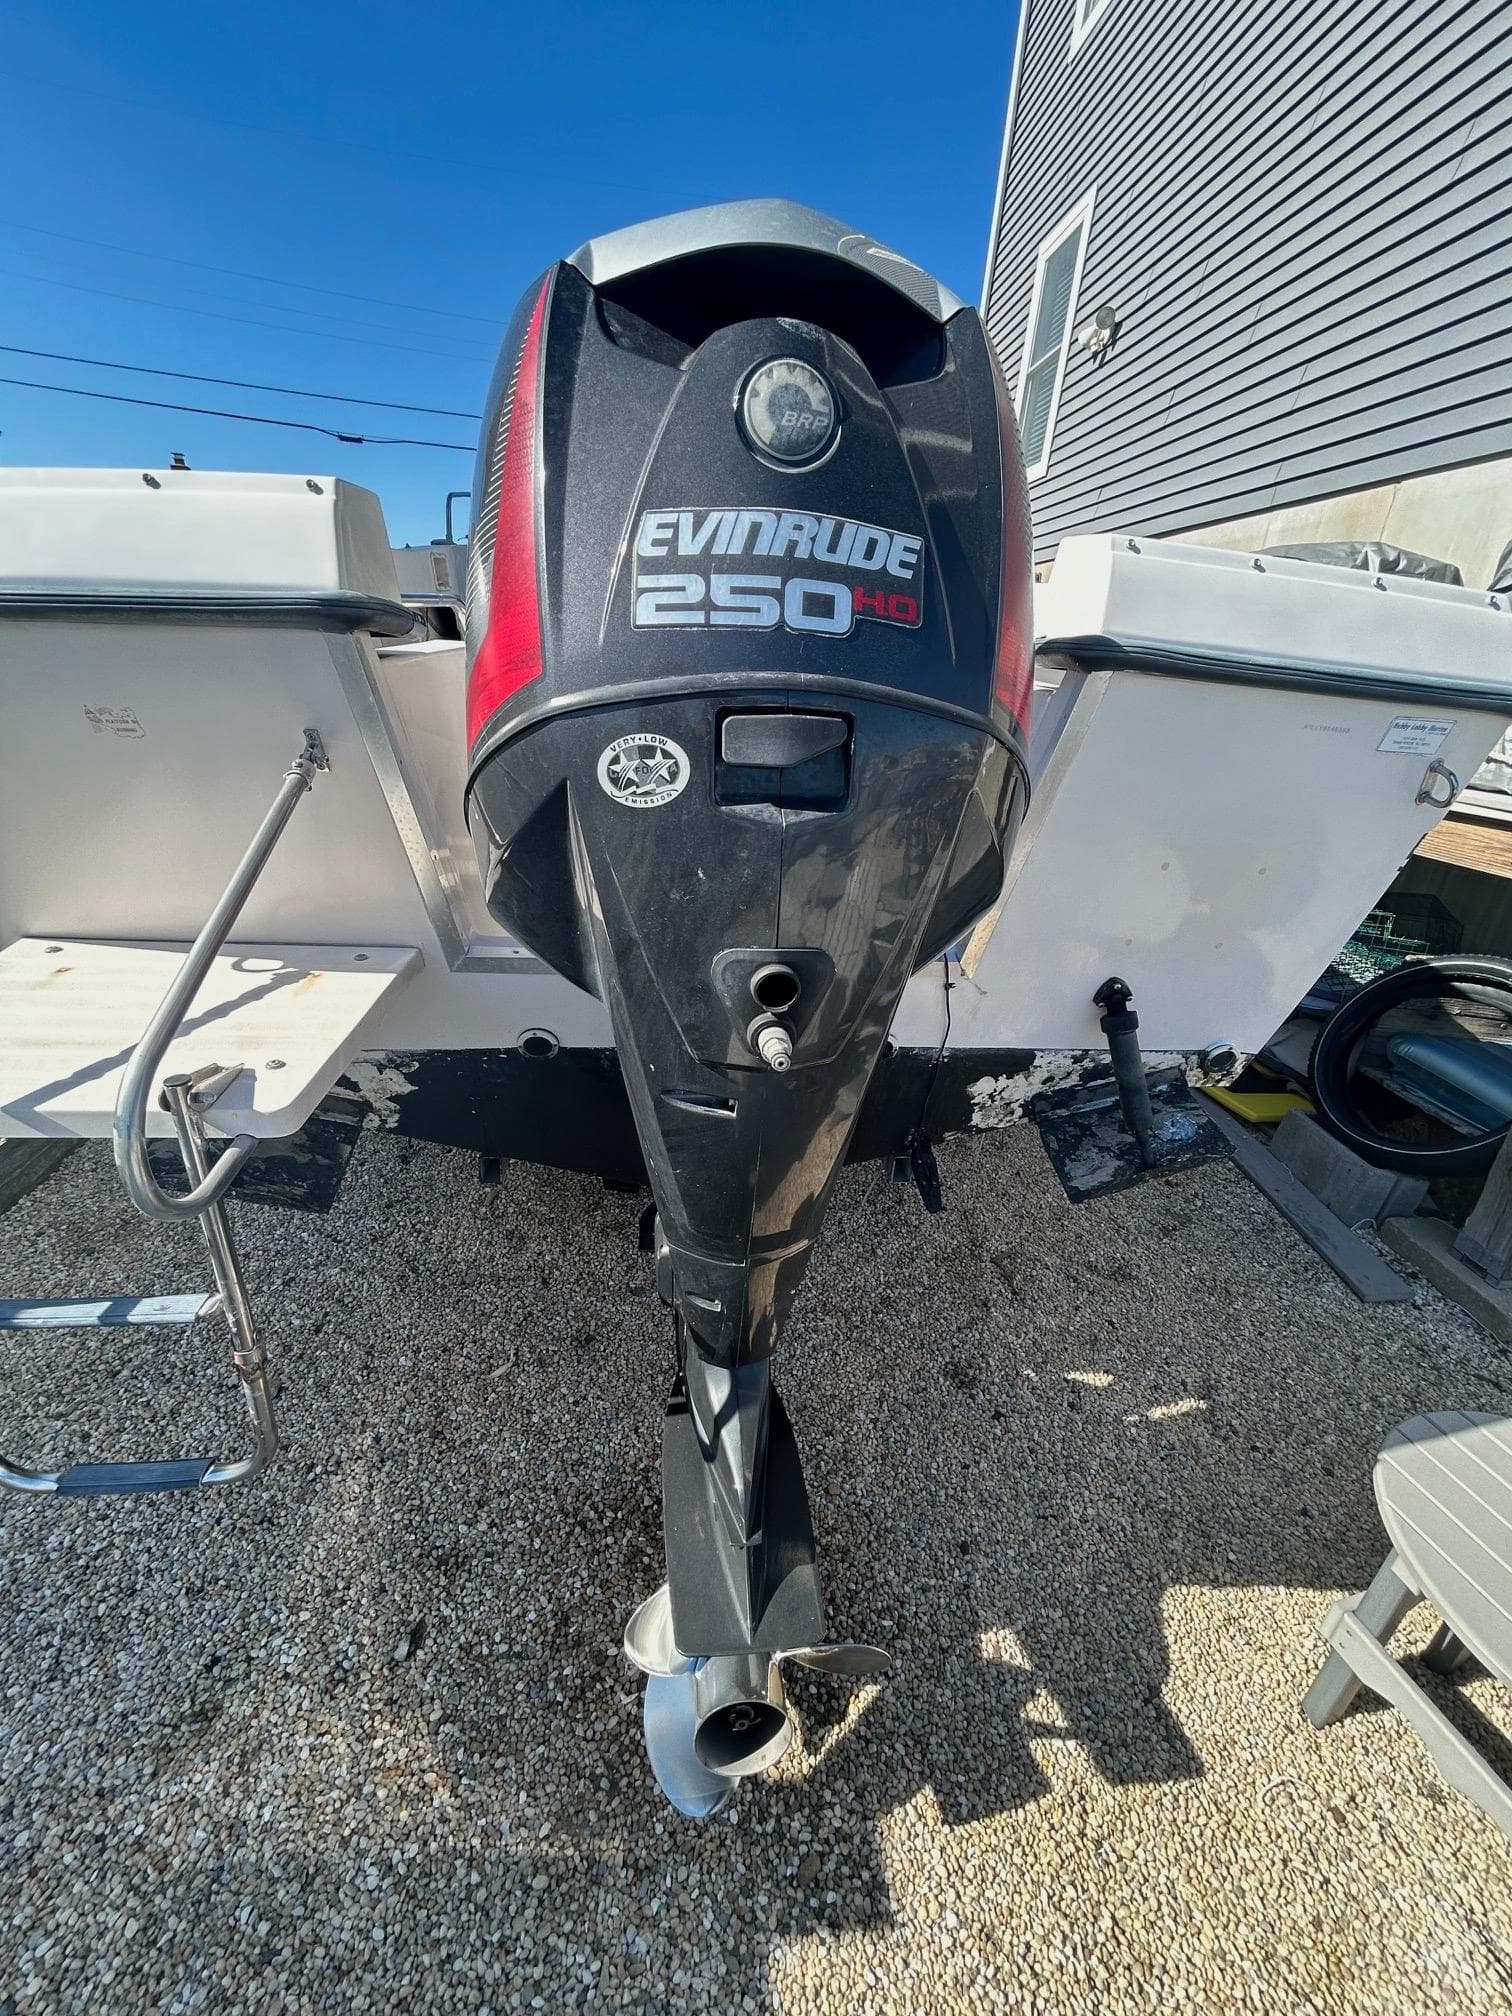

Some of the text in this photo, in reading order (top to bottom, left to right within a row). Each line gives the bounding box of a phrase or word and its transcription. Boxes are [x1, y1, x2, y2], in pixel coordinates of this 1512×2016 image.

[781, 411, 828, 430] BRP
[637, 510, 922, 580] EVINRUDE
[636, 573, 852, 634] 250
[625, 792, 672, 804] EMISSION
